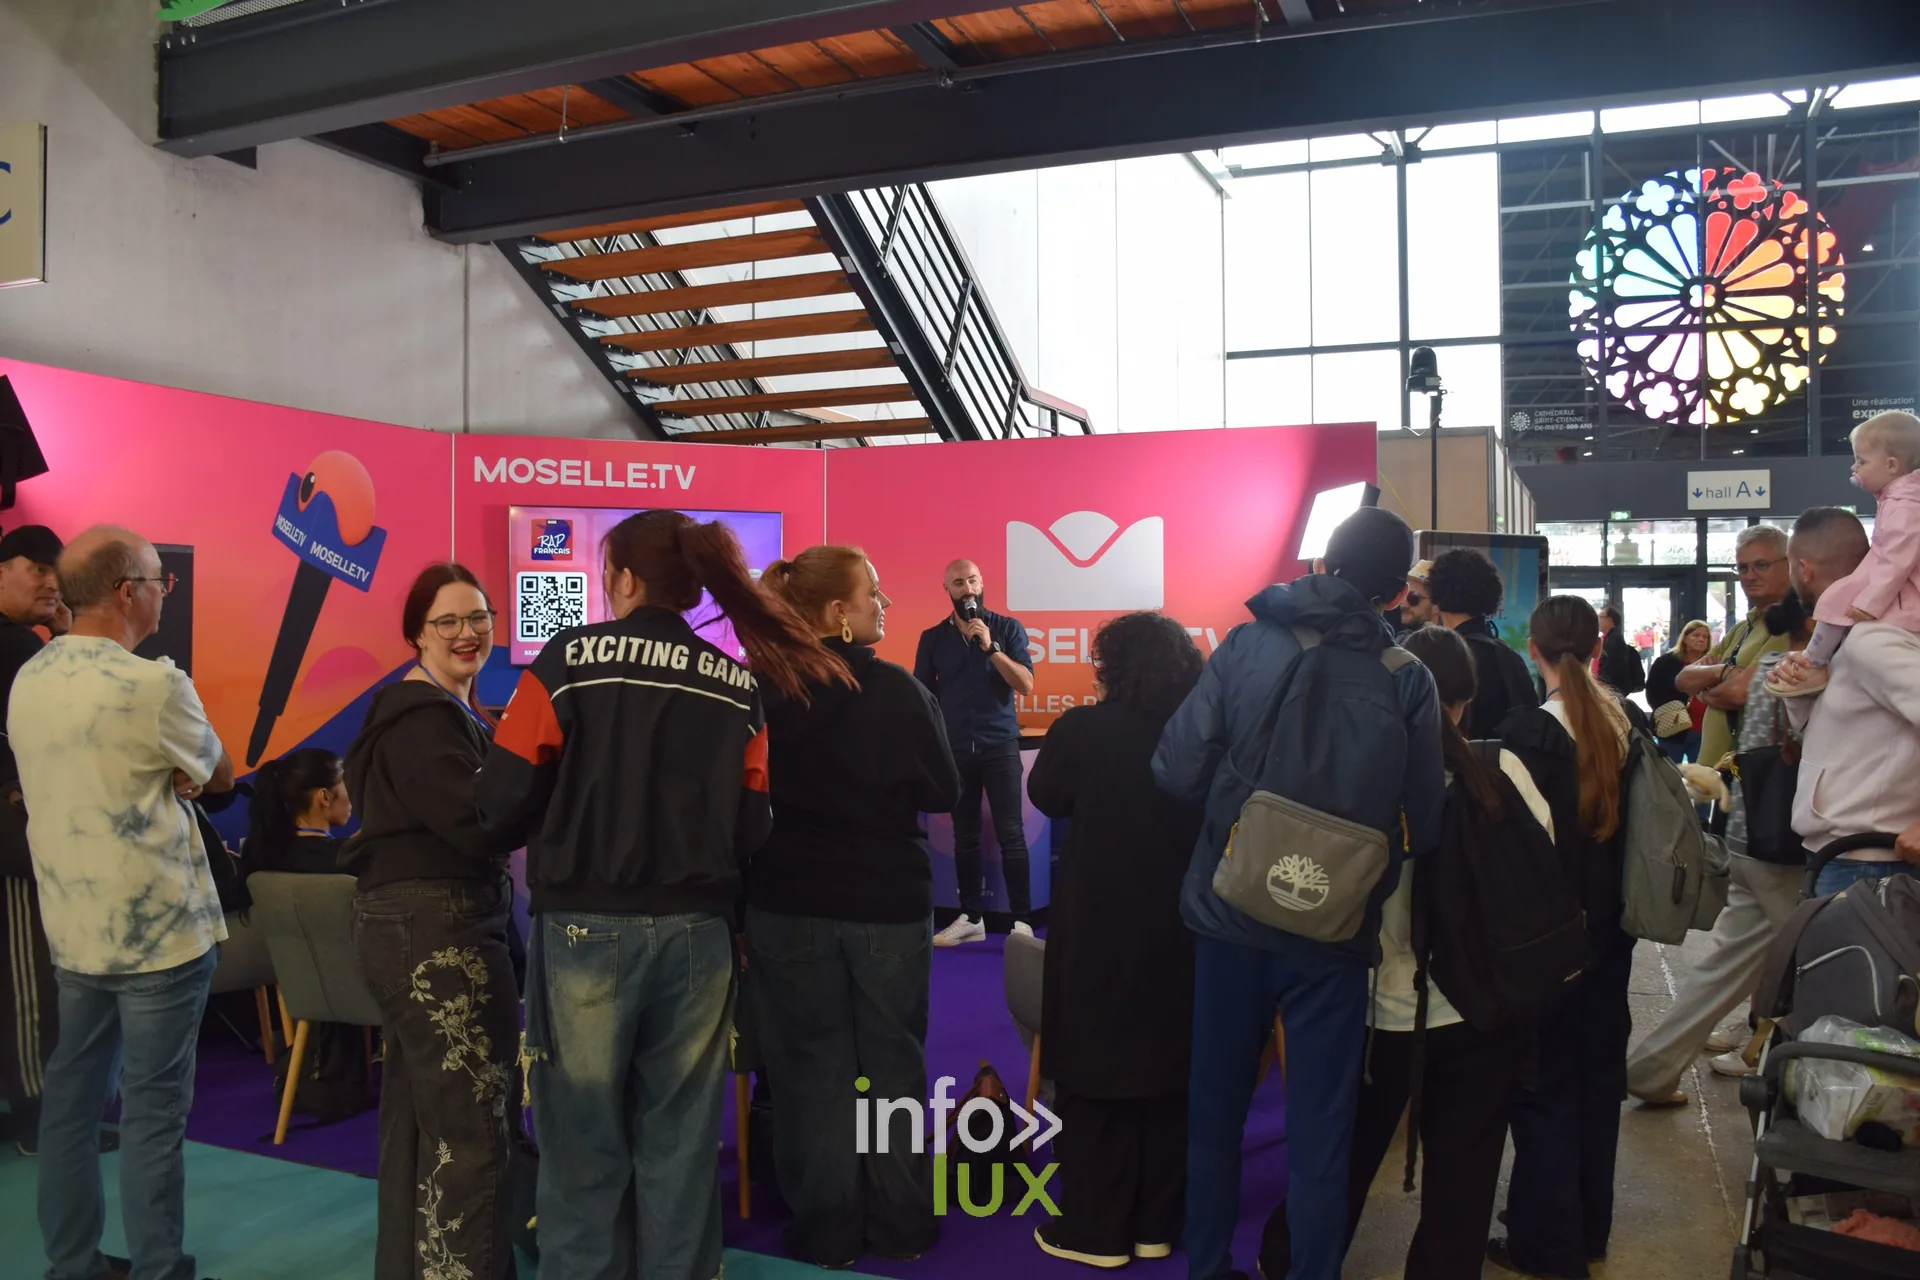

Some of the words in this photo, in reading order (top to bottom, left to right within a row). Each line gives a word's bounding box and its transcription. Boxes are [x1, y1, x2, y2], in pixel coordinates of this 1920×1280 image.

[1870, 396, 1915, 406] réalisation
[473, 456, 696, 490] MOSELLE.TV
[1705, 486, 1731, 499] hall
[1735, 480, 1751, 498] A
[537, 533, 565, 548] RAP
[309, 541, 370, 583] MOSELLE.TV
[566, 635, 690, 671] EXCITING
